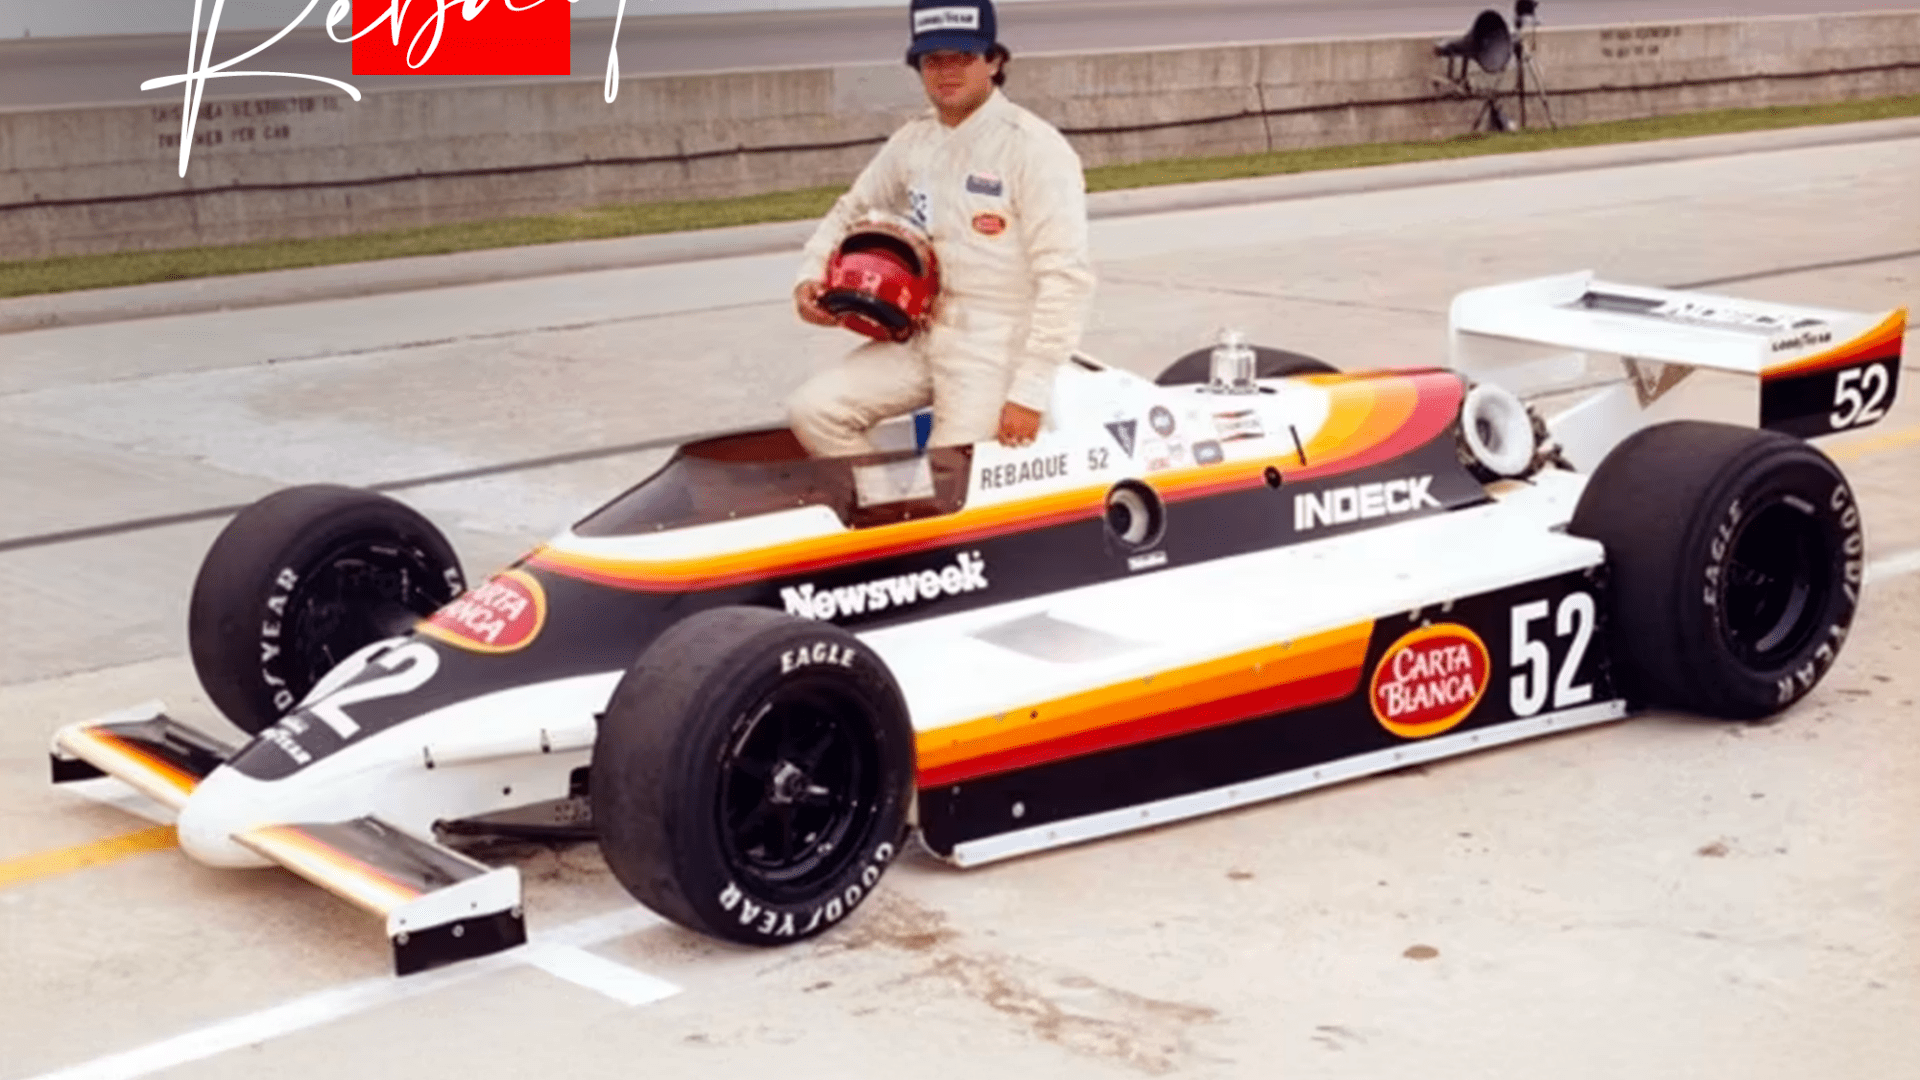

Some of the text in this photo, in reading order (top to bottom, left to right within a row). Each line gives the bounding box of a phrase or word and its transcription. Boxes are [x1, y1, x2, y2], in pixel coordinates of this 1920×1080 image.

[1829, 363, 1889, 429] 52
[980, 448, 1110, 491] REBAQUE 52
[1294, 475, 1442, 531] INDECK
[1703, 499, 1741, 605] EAGLE
[780, 550, 988, 620] Newsweek
[260, 567, 299, 712] DYEAR
[780, 642, 856, 674] EAGLE
[1393, 643, 1473, 683] CARTA
[1510, 591, 1596, 717] 52
[1378, 673, 1477, 717] BLANCA
